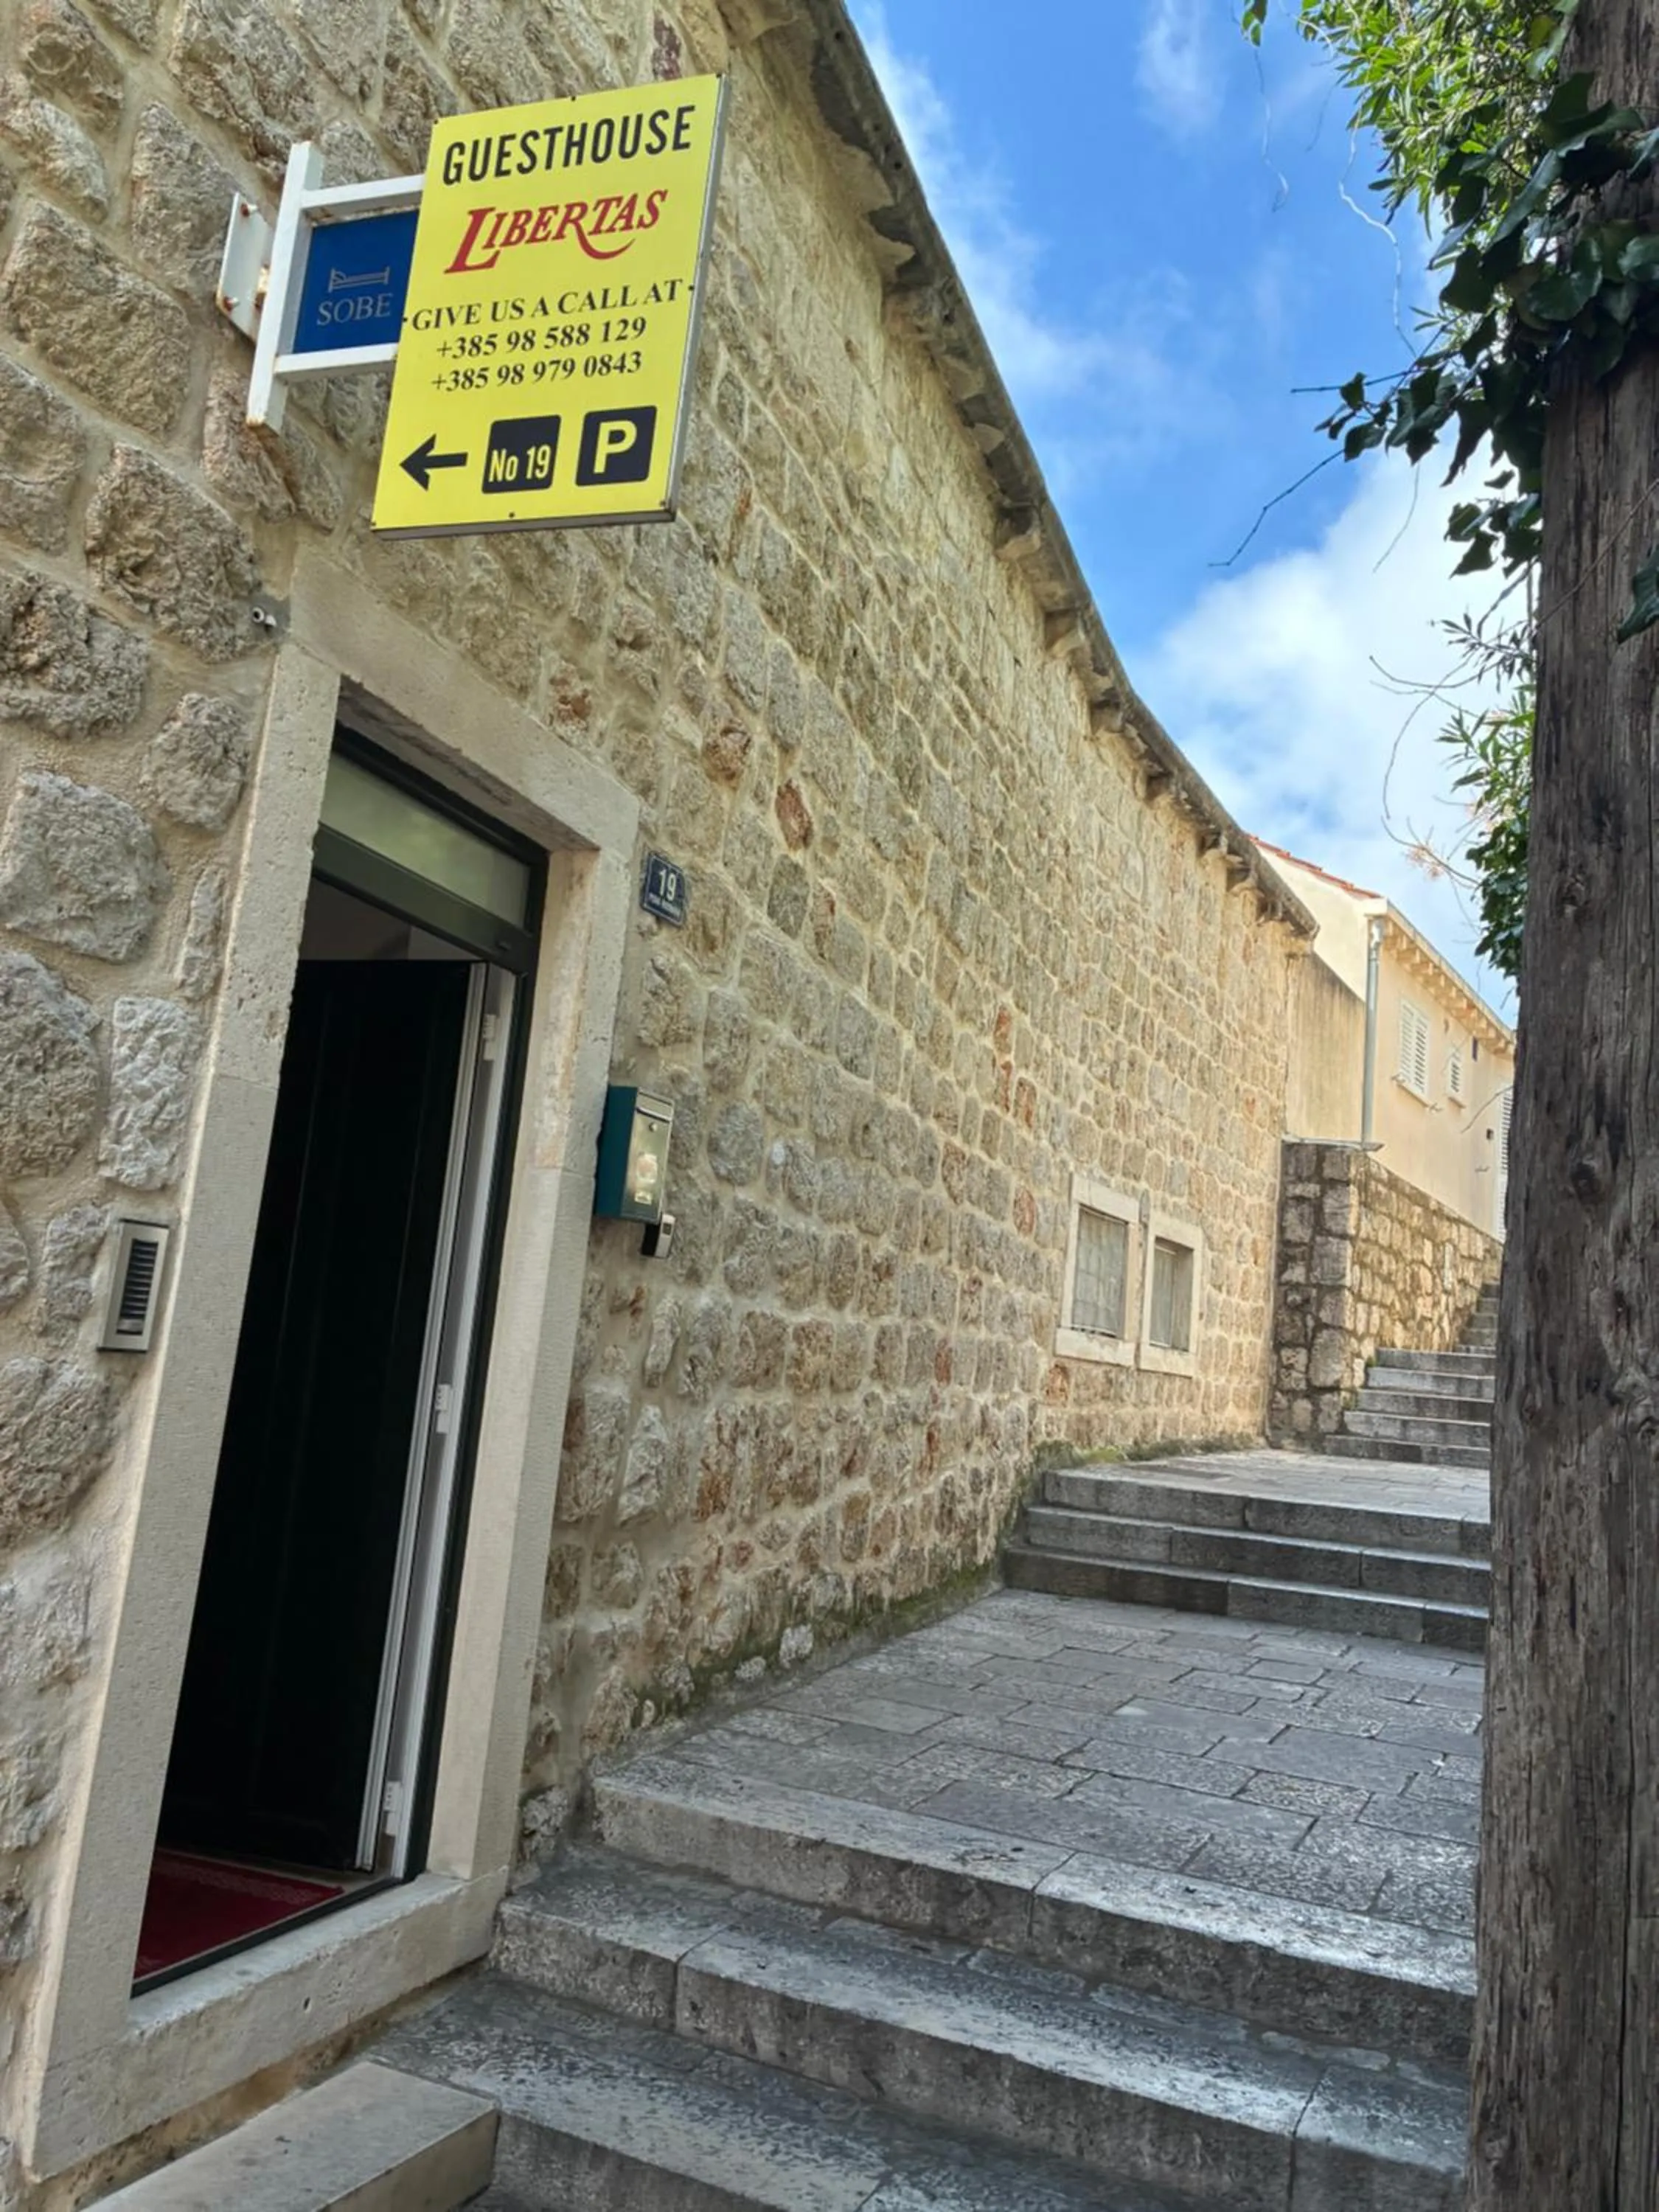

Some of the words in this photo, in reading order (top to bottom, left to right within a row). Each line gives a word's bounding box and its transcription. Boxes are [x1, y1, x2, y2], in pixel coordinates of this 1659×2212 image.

[442, 105, 696, 186] GUESTHOUSE
[444, 189, 668, 274] LIBERTAS
[316, 293, 393, 325] SOBE
[412, 303, 481, 331] GIVE
[490, 299, 524, 323] US
[530, 297, 550, 318] A
[559, 286, 639, 315] CALL
[645, 279, 682, 303] AT
[436, 333, 498, 361] +385
[506, 329, 537, 352] 98
[543, 323, 591, 347] 588
[600, 316, 647, 341] 129
[431, 366, 490, 393] +385
[496, 362, 527, 386] 98
[532, 357, 577, 382] 979
[583, 350, 642, 378] 0843
[489, 450, 518, 482] No
[526, 444, 552, 479] 19
[593, 420, 638, 474] P
[659, 869, 677, 902] 19
